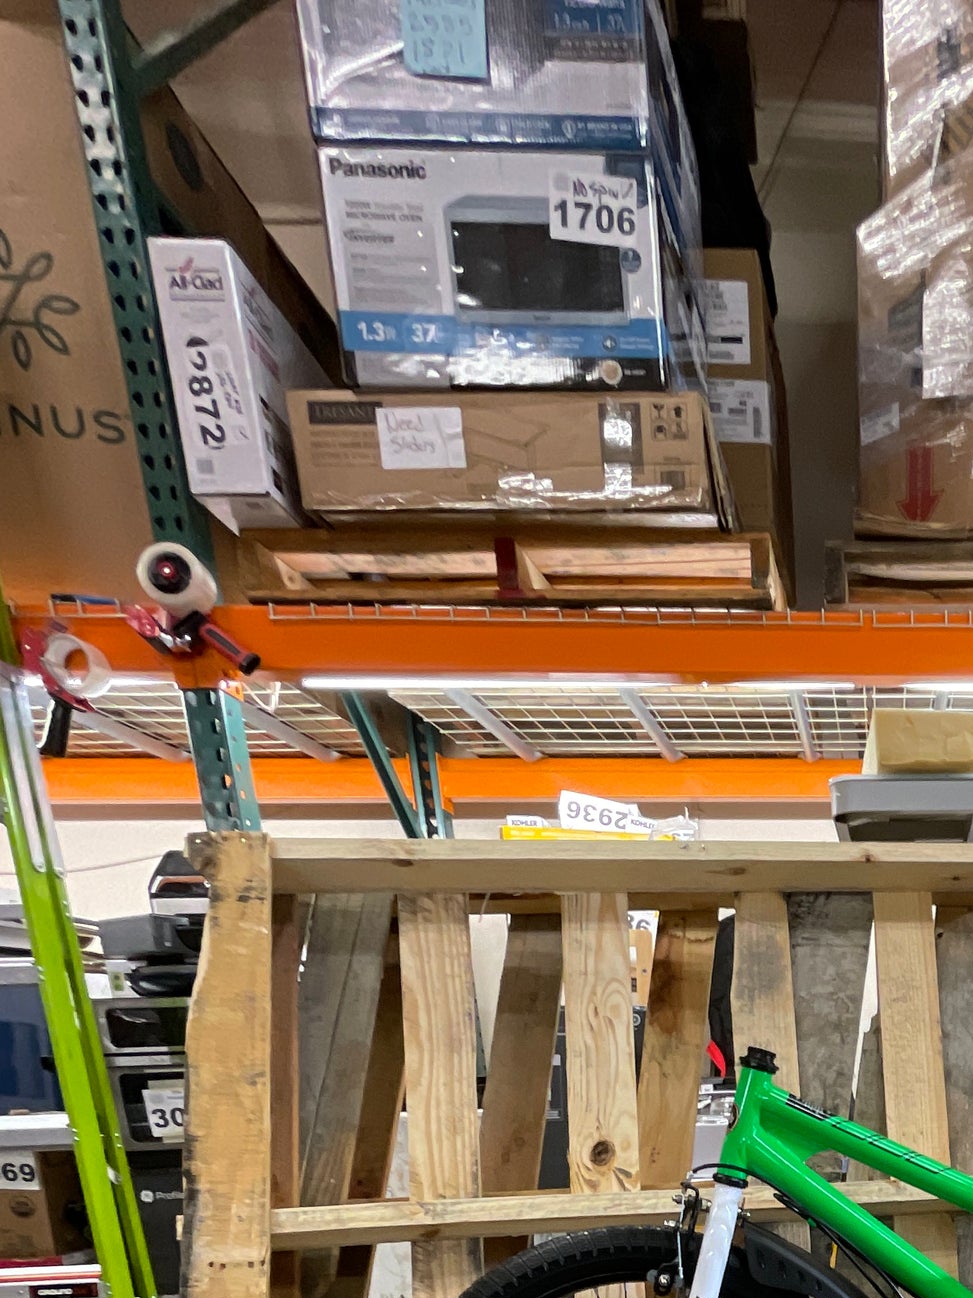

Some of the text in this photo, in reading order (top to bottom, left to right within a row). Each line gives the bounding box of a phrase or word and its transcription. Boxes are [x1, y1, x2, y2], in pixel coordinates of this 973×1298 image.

[329, 157, 428, 180] Panasonic
[553, 198, 636, 236] 1706
[169, 273, 224, 291] All-Clad
[384, 411, 425, 434] Need
[566, 800, 629, 831] 2936
[1, 1162, 36, 1183] 69
